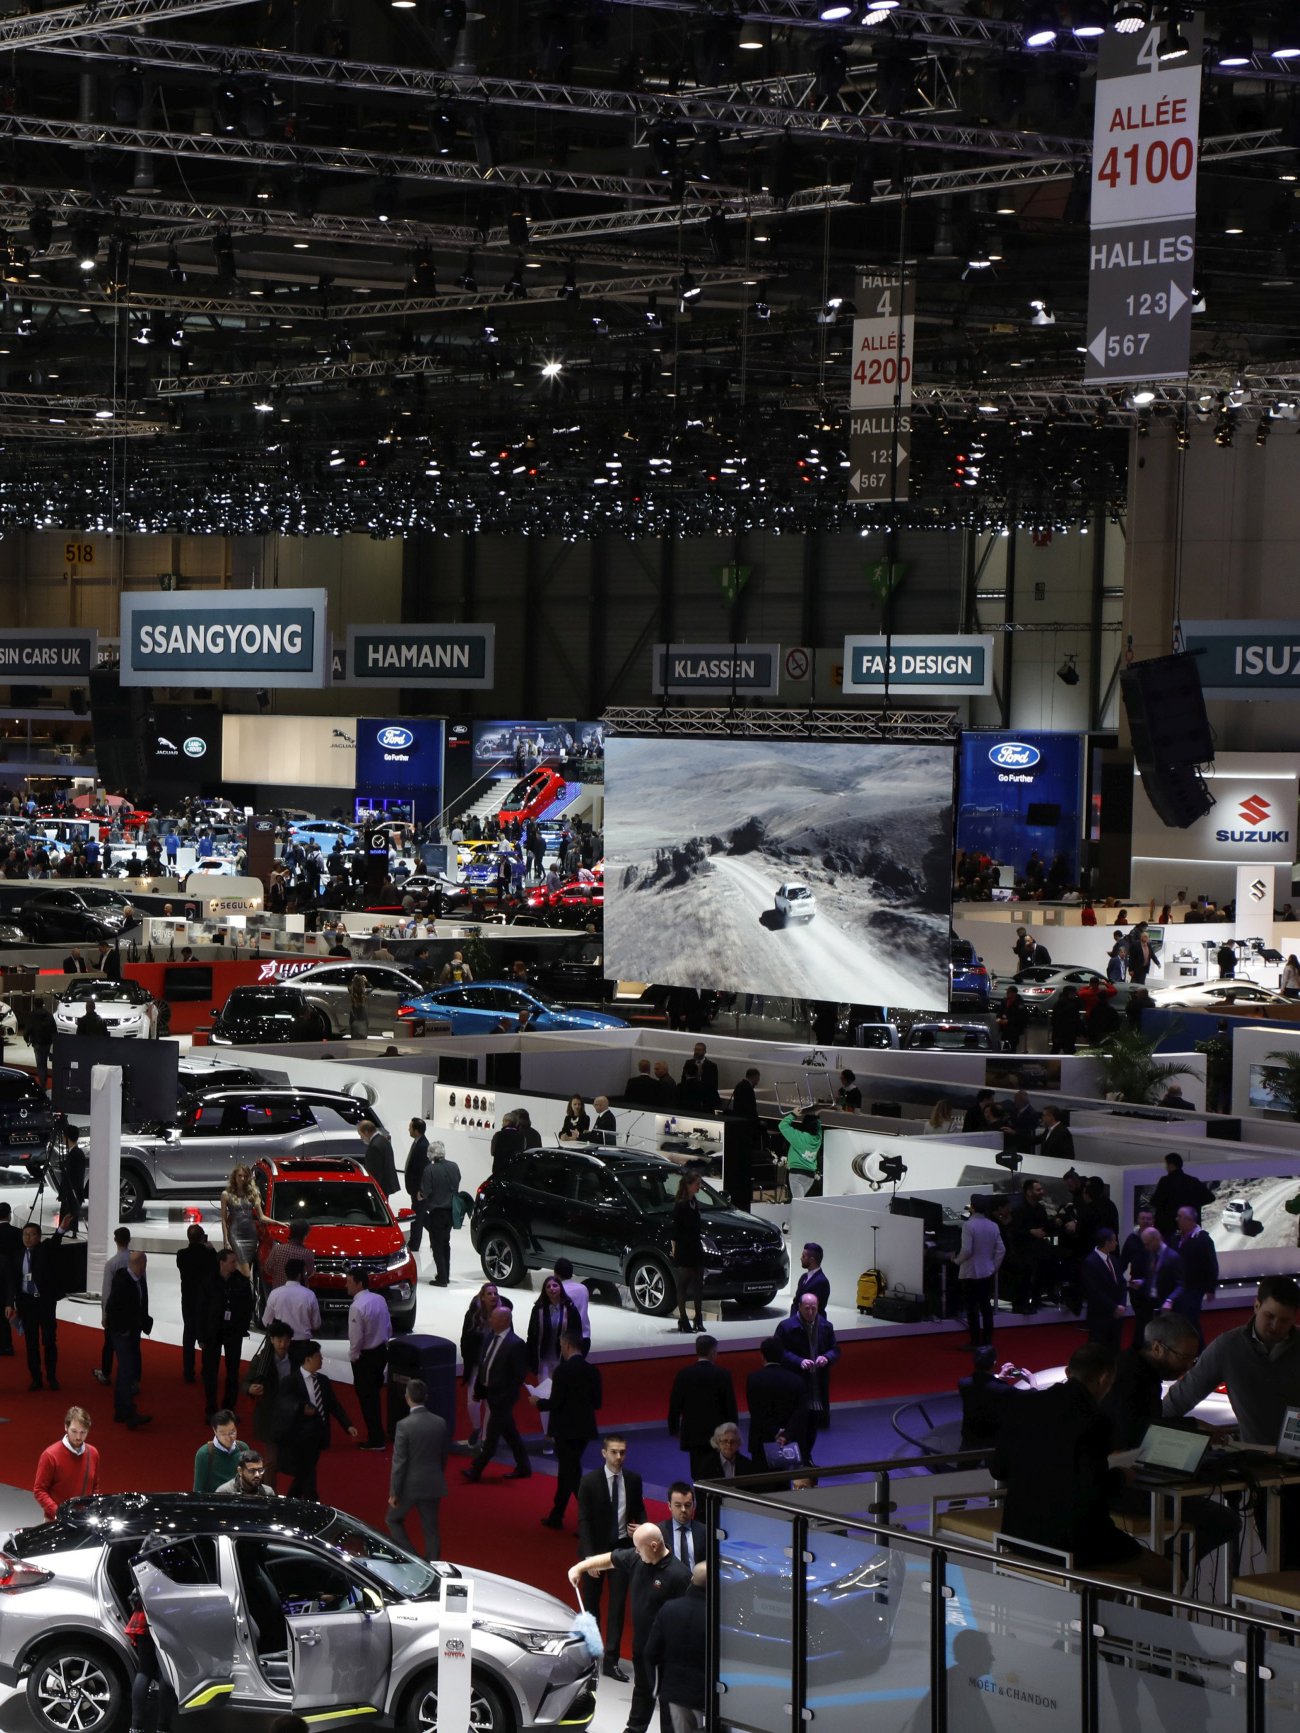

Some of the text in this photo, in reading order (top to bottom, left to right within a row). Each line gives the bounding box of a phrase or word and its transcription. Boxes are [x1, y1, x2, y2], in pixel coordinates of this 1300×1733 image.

[1137, 27, 1161, 73] 4
[1109, 95, 1187, 132] ALLÉE
[1098, 138, 1193, 188] 4100
[1091, 236, 1193, 270] HALLES
[876, 290, 892, 318] 4
[1126, 293, 1167, 316] 123
[861, 331, 905, 352] ALLÉE
[1108, 334, 1150, 357] 567
[853, 358, 910, 385] 4200
[861, 474, 886, 487] 567
[66, 545, 93, 562] 518
[140, 624, 302, 654] SSANGYONG
[23, 648, 56, 664] CARS
[62, 648, 80, 664] UK
[368, 645, 469, 668] HAMANN
[902, 655, 971, 675] DESIGN
[675, 660, 754, 679] KLASSEN
[383, 729, 406, 744] Ford
[392, 754, 409, 762] Further
[997, 746, 1029, 764] Ford
[998, 774, 1033, 783] Go Further
[1216, 830, 1289, 842] SUZUKI
[220, 902, 254, 910] SEGULA
[968, 1677, 1058, 1710] MOËT & CHANDON
